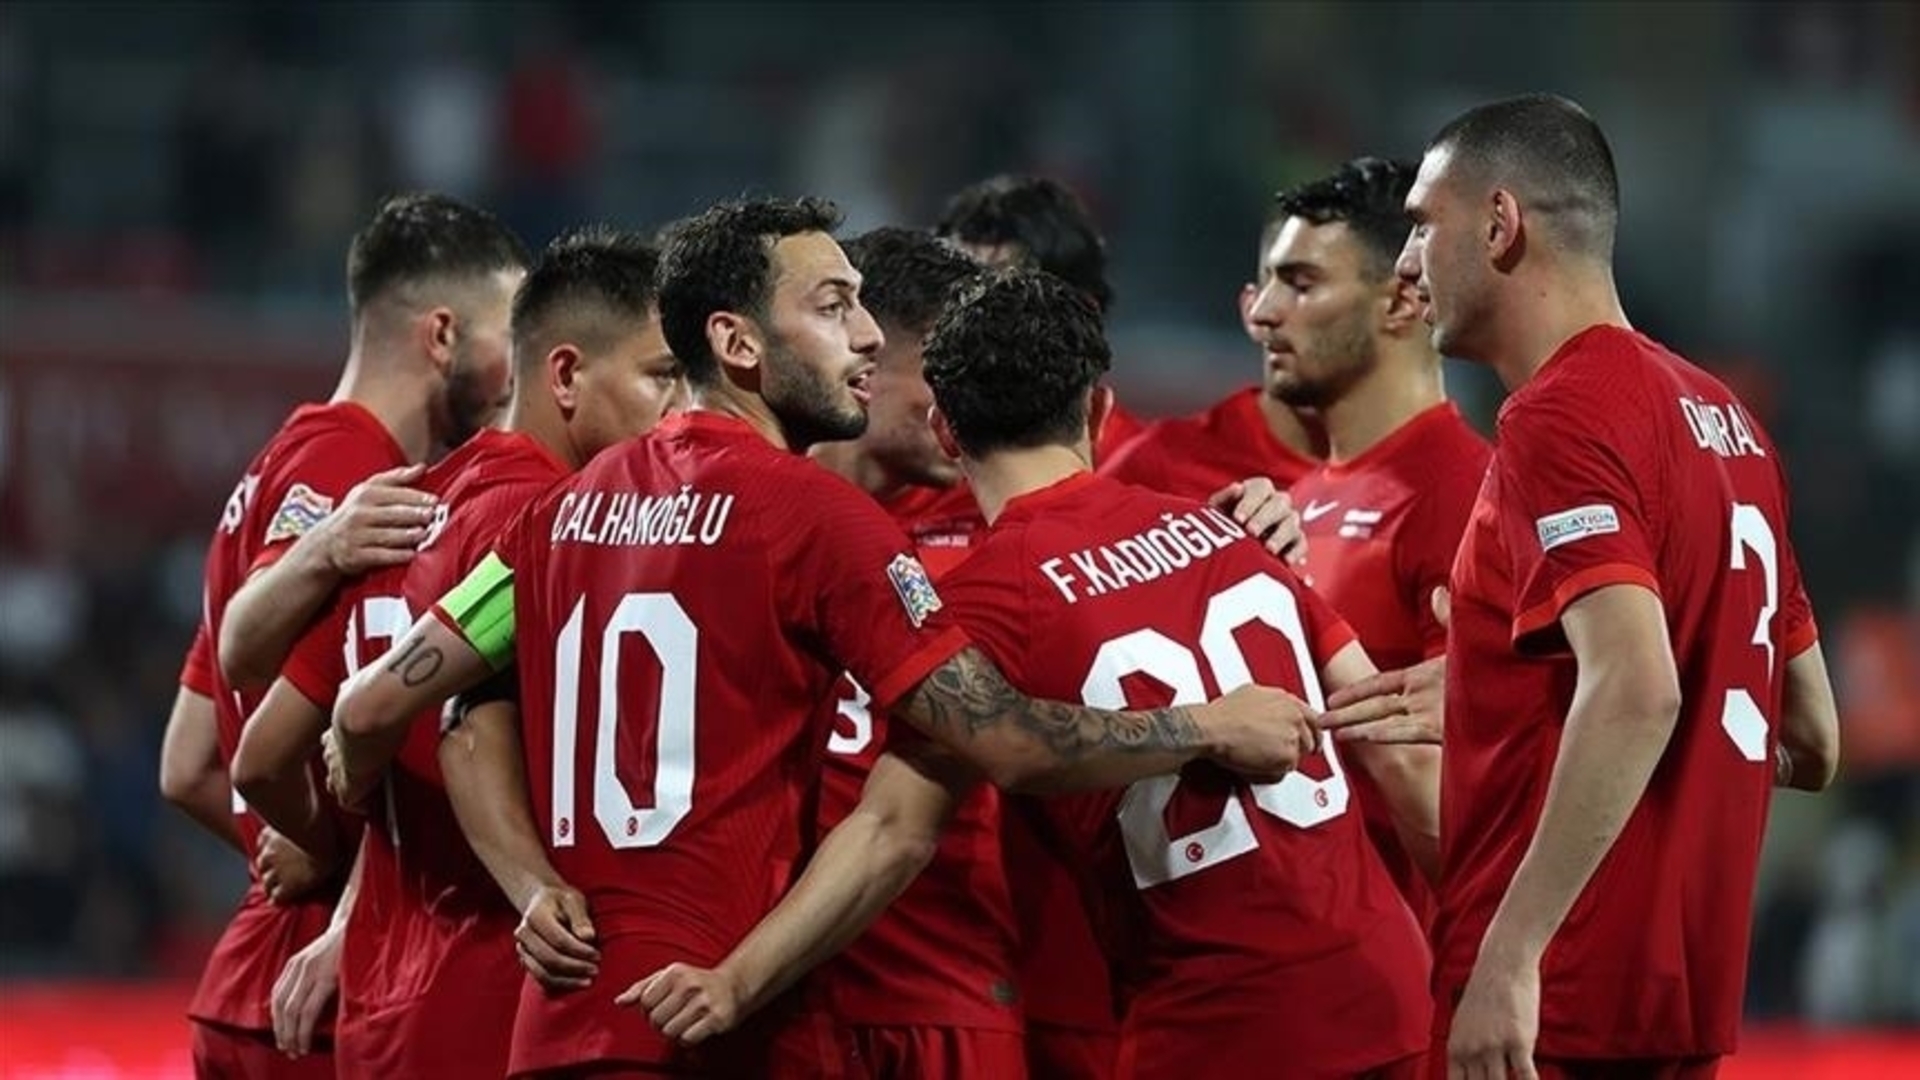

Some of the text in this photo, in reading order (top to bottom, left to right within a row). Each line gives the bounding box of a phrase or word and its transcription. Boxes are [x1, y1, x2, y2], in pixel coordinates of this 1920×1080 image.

[387, 634, 443, 687] 10
[1040, 507, 1247, 603] F.KADIOĞLU
[1721, 500, 1778, 762] 3
[552, 592, 698, 850] 10
[1080, 571, 1351, 890] 20
